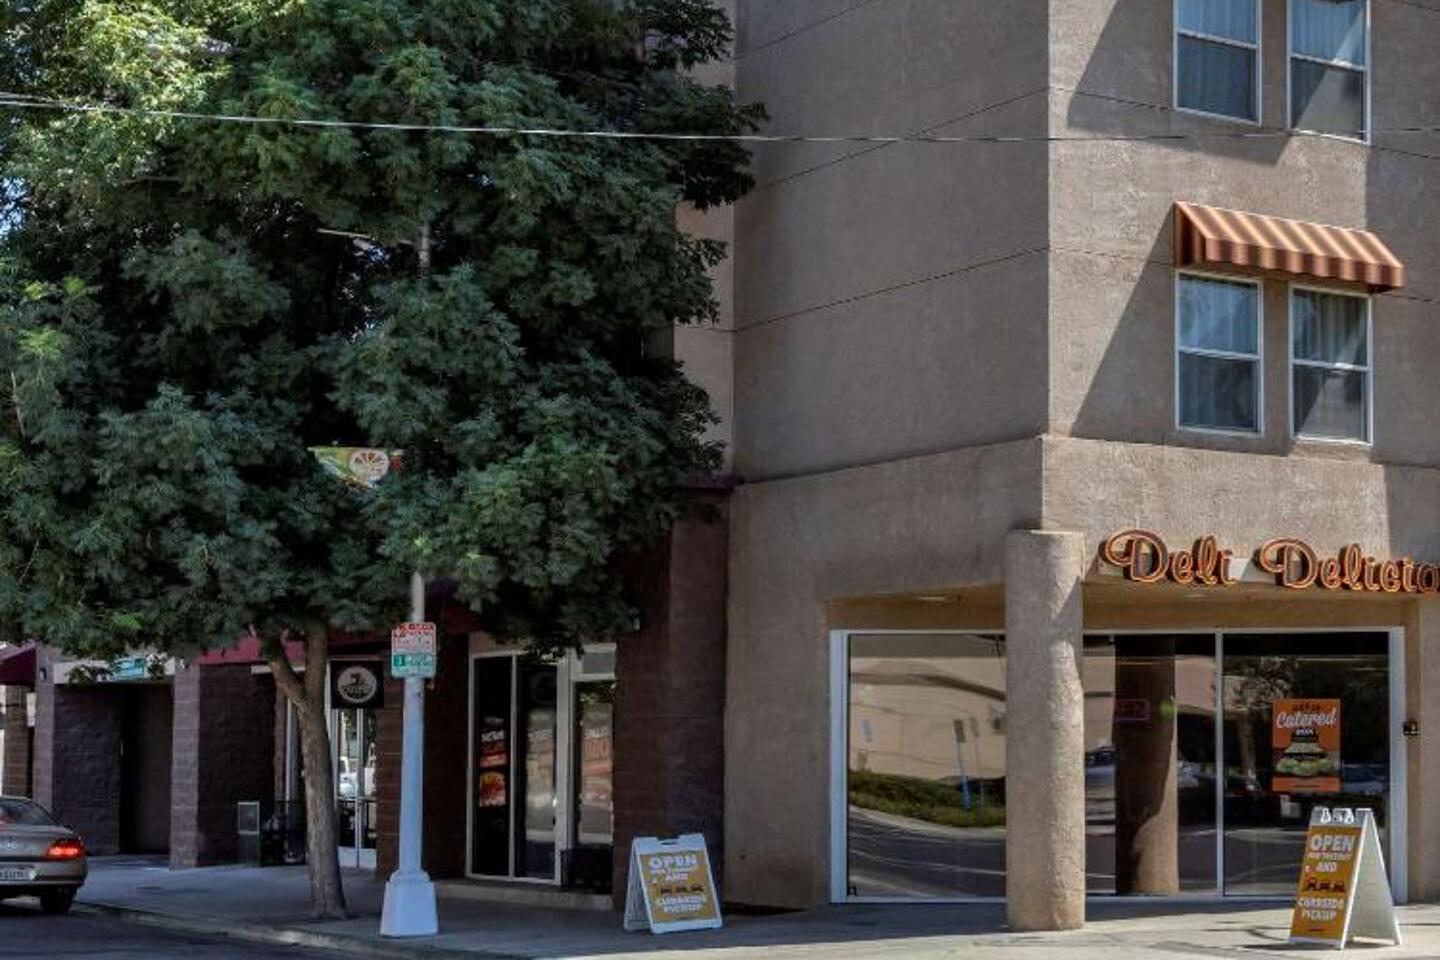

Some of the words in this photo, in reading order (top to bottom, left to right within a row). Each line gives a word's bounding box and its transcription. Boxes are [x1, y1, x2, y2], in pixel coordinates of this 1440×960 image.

[1103, 528, 1237, 585] Deli
[1276, 707, 1337, 729] Catered
[1310, 834, 1356, 851] OPEN
[648, 854, 697, 870] OPEN
[1316, 861, 1338, 872] AND
